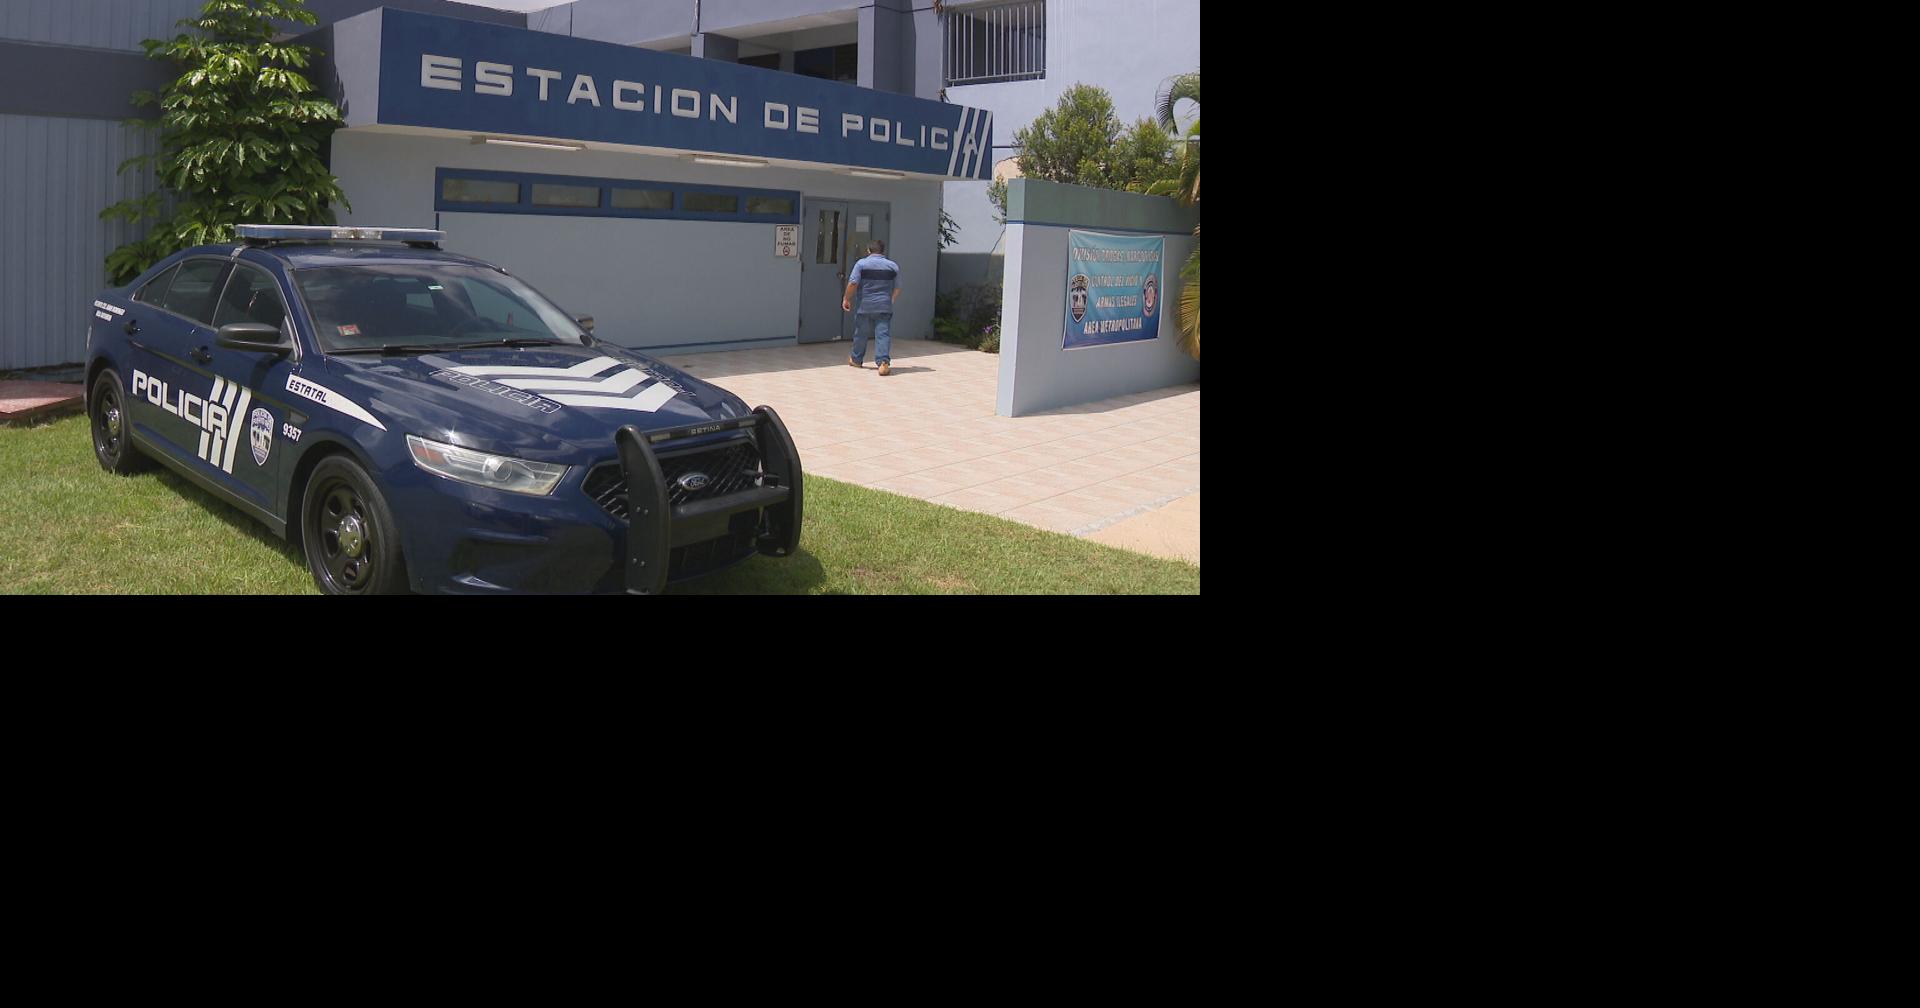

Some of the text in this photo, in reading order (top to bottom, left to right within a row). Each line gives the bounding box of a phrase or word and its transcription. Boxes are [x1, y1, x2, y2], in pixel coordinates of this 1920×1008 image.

[420, 53, 978, 155] ESTACION DE POLICIA
[132, 368, 229, 440] POLICIA
[288, 379, 327, 404] ESTATAL
[282, 422, 302, 442] 9357
